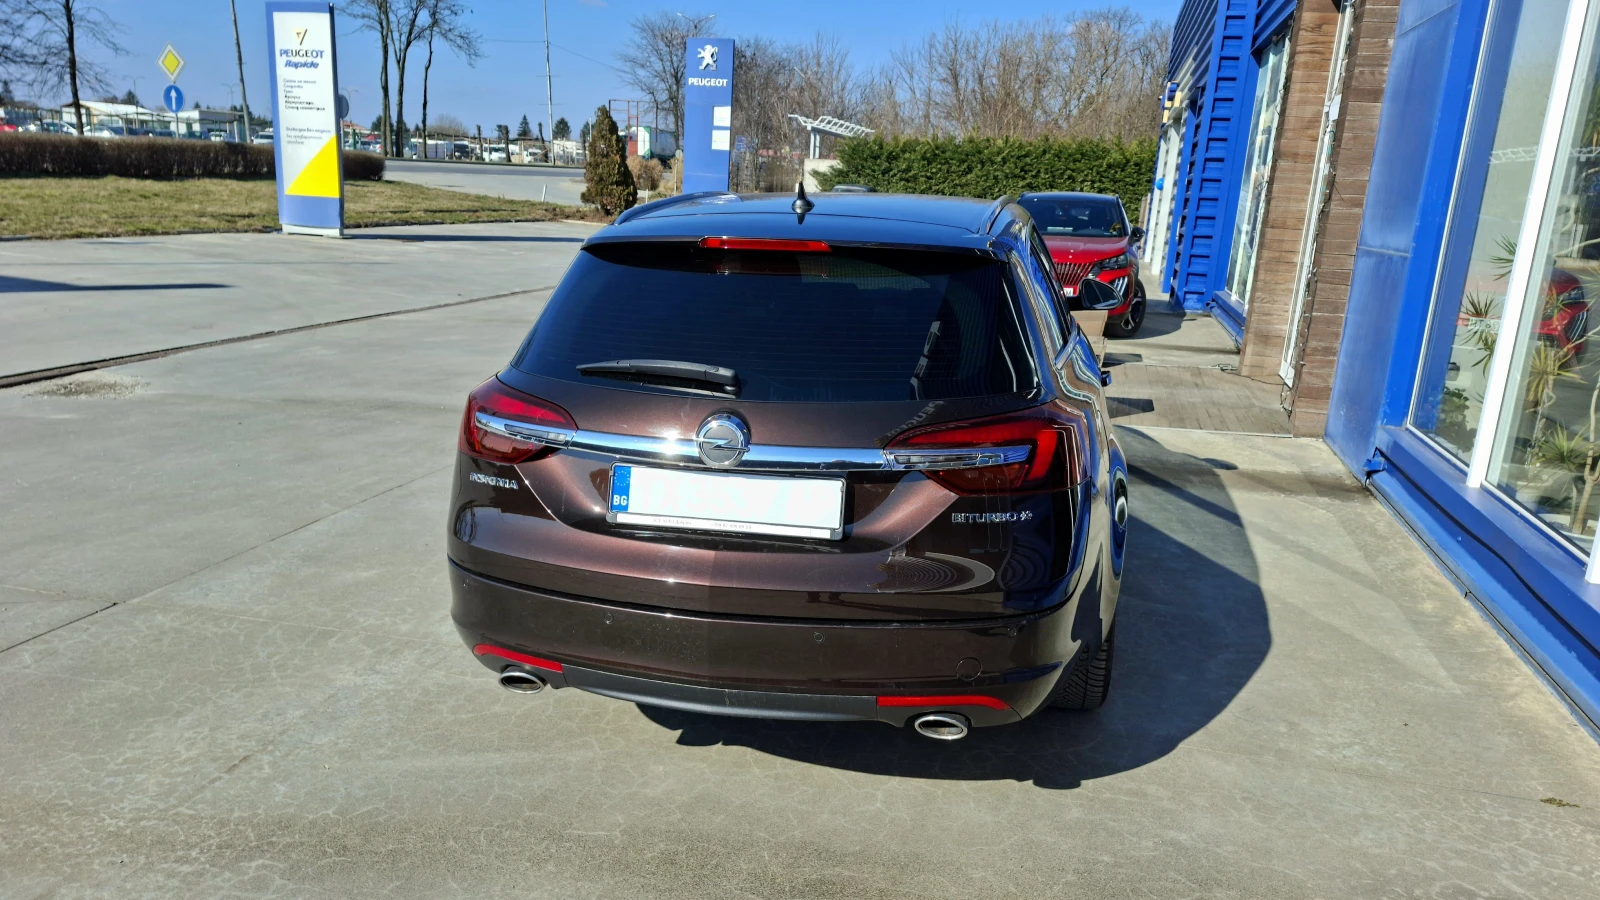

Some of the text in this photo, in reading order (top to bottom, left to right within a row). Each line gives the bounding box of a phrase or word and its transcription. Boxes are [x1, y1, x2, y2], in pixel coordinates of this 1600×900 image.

[279, 49, 325, 58] PEUGEOT
[688, 77, 728, 87] PEUGEOT
[470, 472, 519, 490] INSIGNIA
[613, 494, 628, 506] BG
[951, 511, 1019, 523] BITURBO
